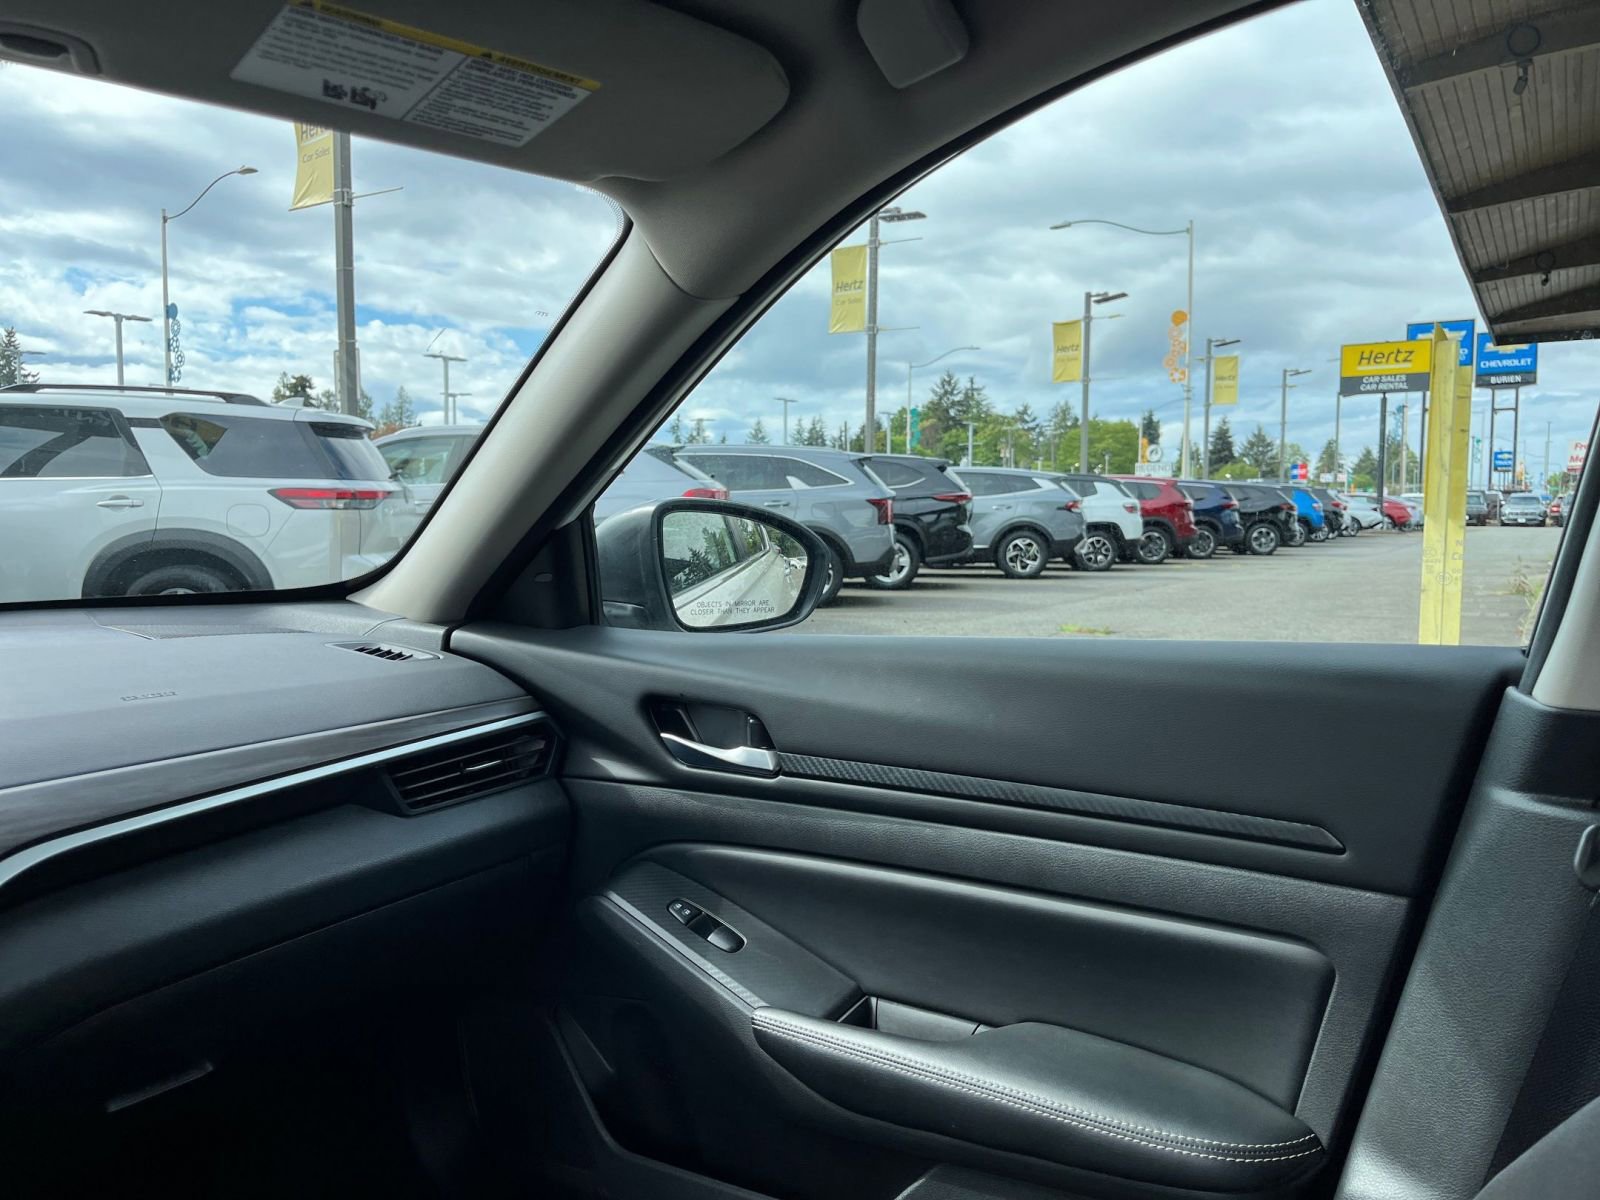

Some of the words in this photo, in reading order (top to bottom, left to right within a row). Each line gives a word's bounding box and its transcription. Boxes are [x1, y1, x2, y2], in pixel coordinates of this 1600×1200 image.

[303, 153, 314, 163] Car
[835, 280, 864, 293] Hertz
[1358, 348, 1415, 366] Hertz
[1480, 358, 1532, 368] CHEVROLET
[1362, 376, 1380, 384] CAR
[1490, 374, 1522, 384] BURIEN
[1360, 383, 1377, 391] CAR
[1378, 382, 1409, 390] RENTAL
[690, 608, 714, 616] CLOSER
